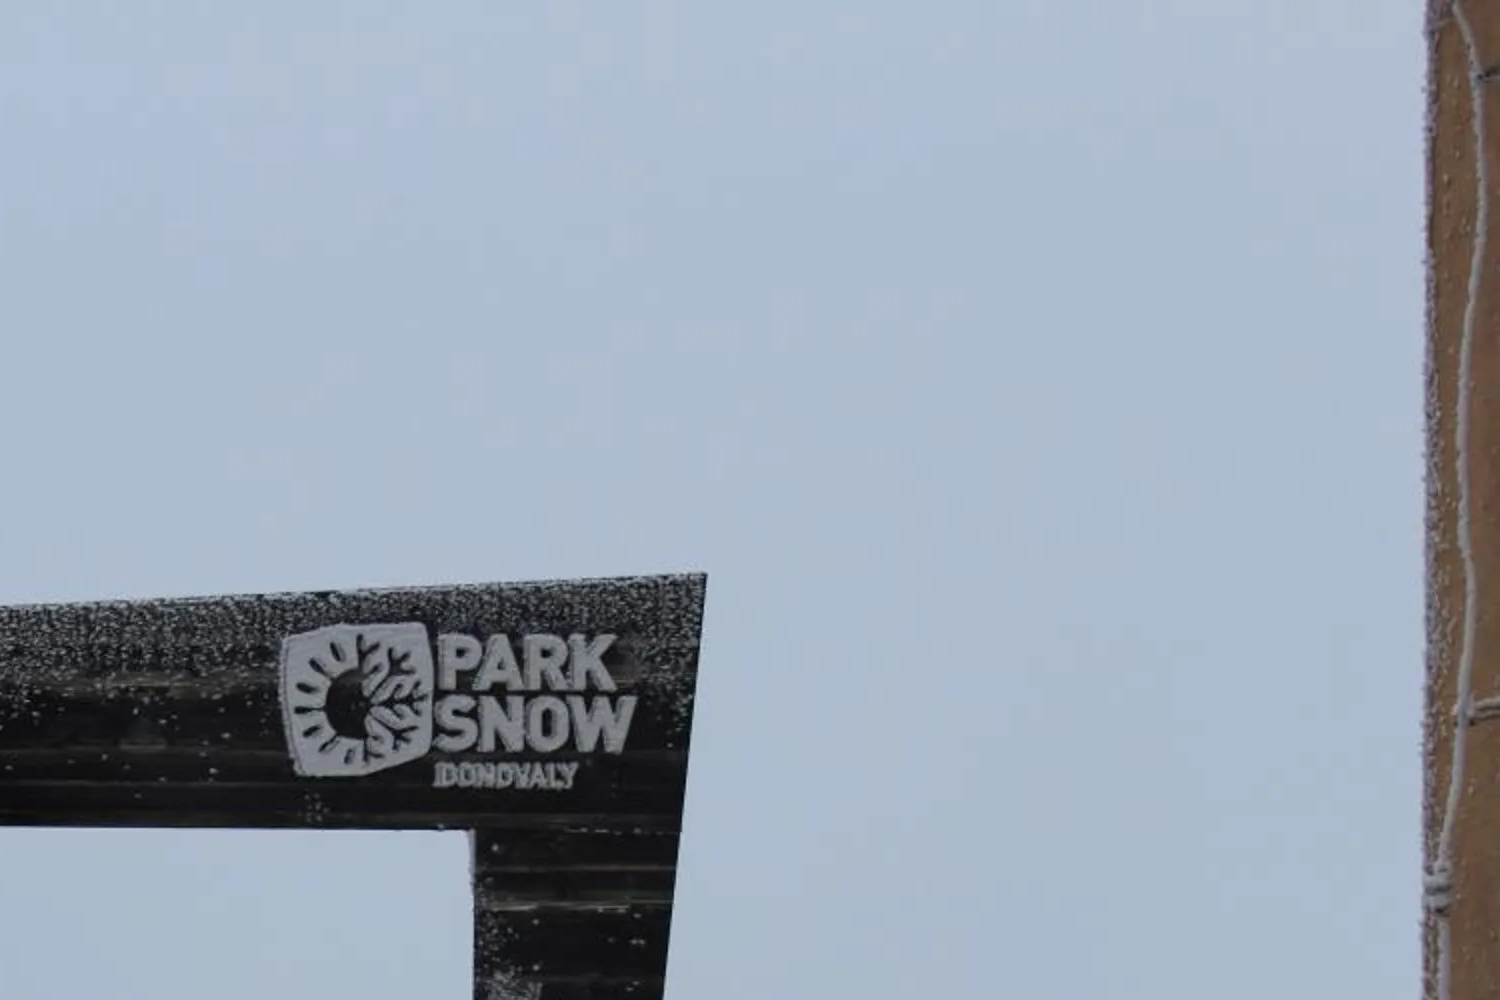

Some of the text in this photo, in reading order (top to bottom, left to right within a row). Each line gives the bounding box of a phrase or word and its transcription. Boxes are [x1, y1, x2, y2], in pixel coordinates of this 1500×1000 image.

[436, 633, 618, 692] PARK
[432, 695, 638, 754] SNOW
[432, 762, 579, 790] DONOVALY
